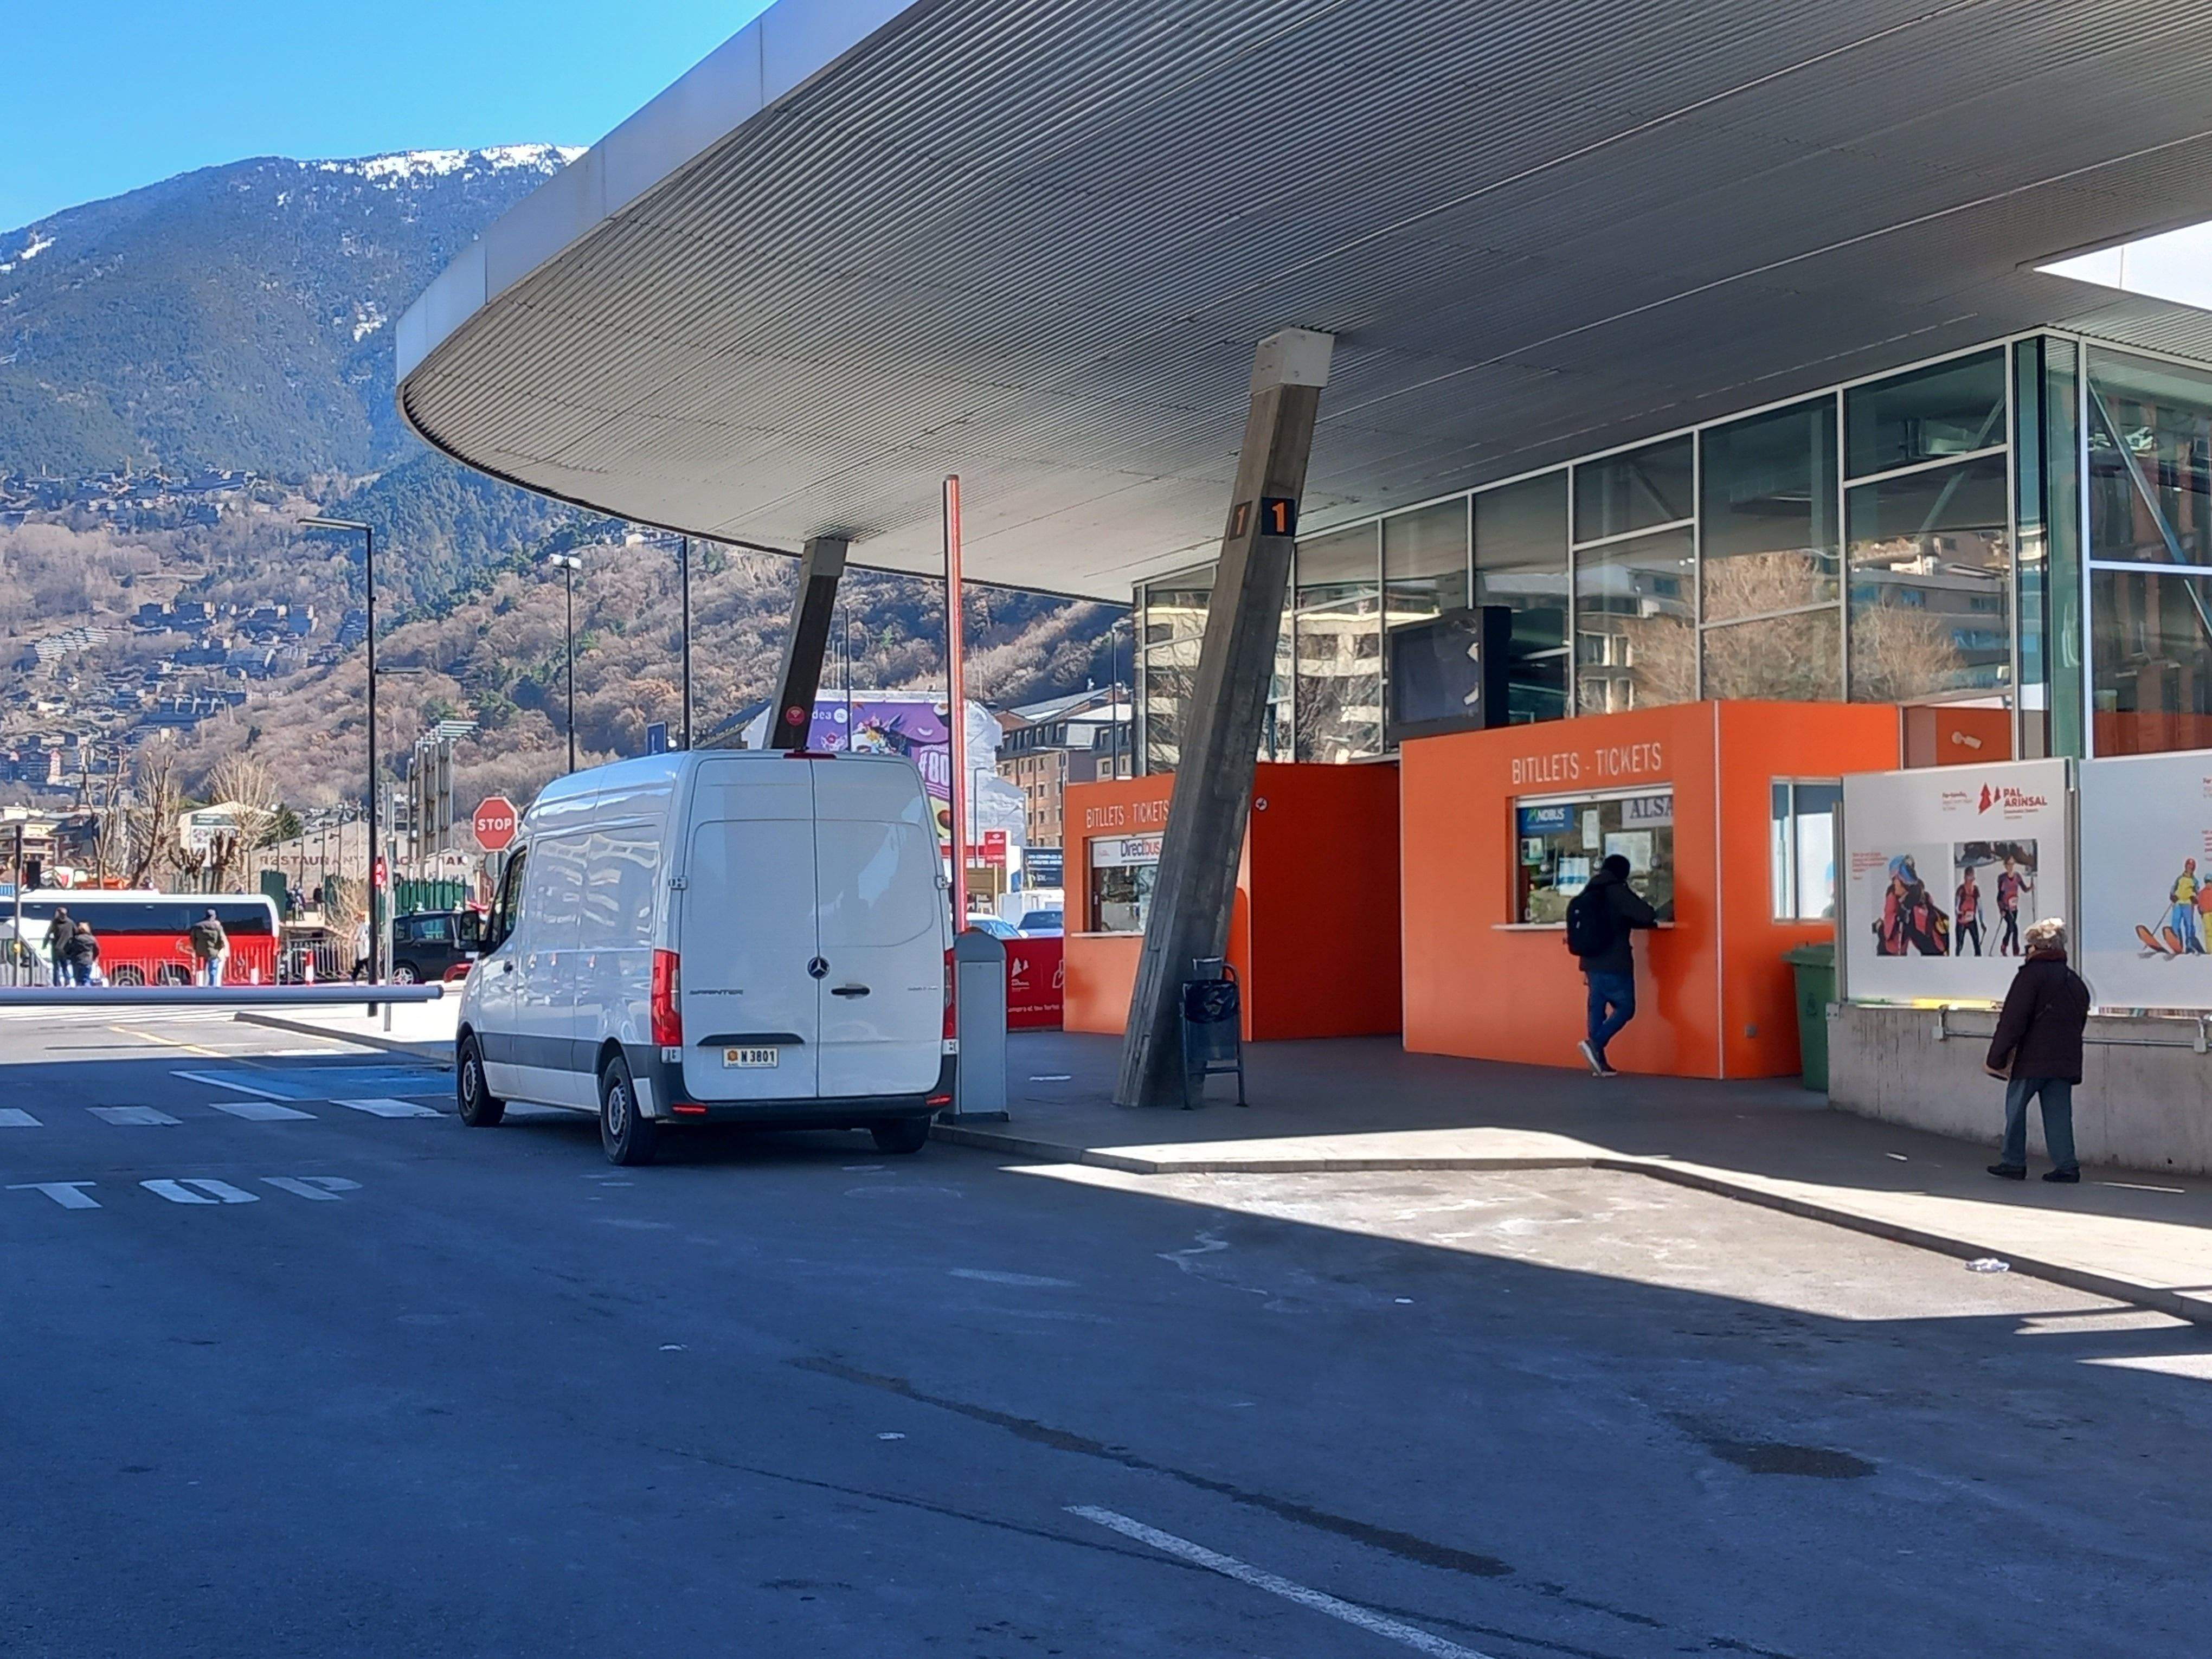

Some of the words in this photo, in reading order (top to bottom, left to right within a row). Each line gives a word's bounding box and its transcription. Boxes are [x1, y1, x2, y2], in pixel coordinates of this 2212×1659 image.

[1237, 506, 1246, 535] 1
[1272, 502, 1285, 532] 1
[1512, 752, 1579, 785] BITLLETS
[1595, 741, 1662, 776] TICKETS
[2003, 787, 2022, 798] PAL
[2004, 795, 2048, 807] ARINSAL
[1086, 805, 1124, 828] BITLLETS
[1132, 799, 1170, 824] TICKETS
[478, 818, 512, 831] STOP
[750, 1050, 775, 1062] 3801
